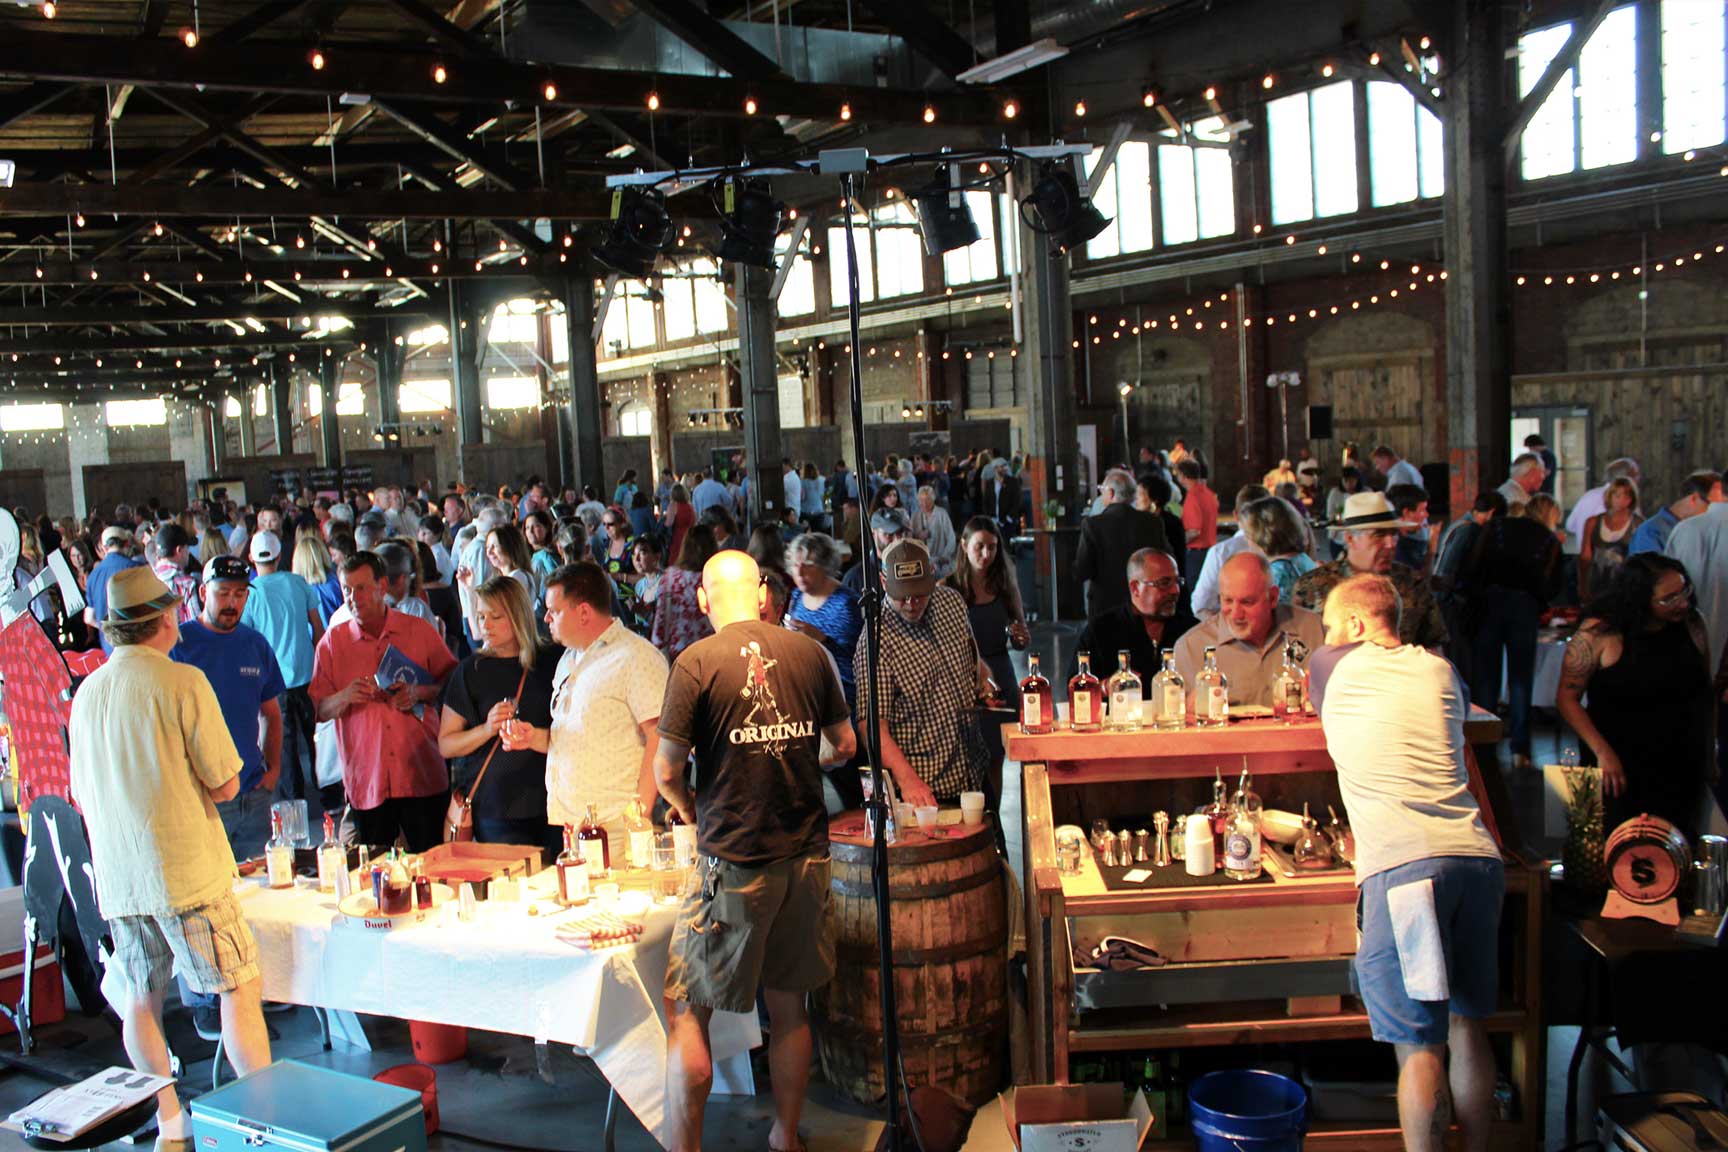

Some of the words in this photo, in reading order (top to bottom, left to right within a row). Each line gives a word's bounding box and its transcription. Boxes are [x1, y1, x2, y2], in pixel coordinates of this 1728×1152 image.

[729, 721, 815, 744] ORIGINAL
[364, 919, 392, 928] Duvel
[1074, 1137, 1086, 1148] S
